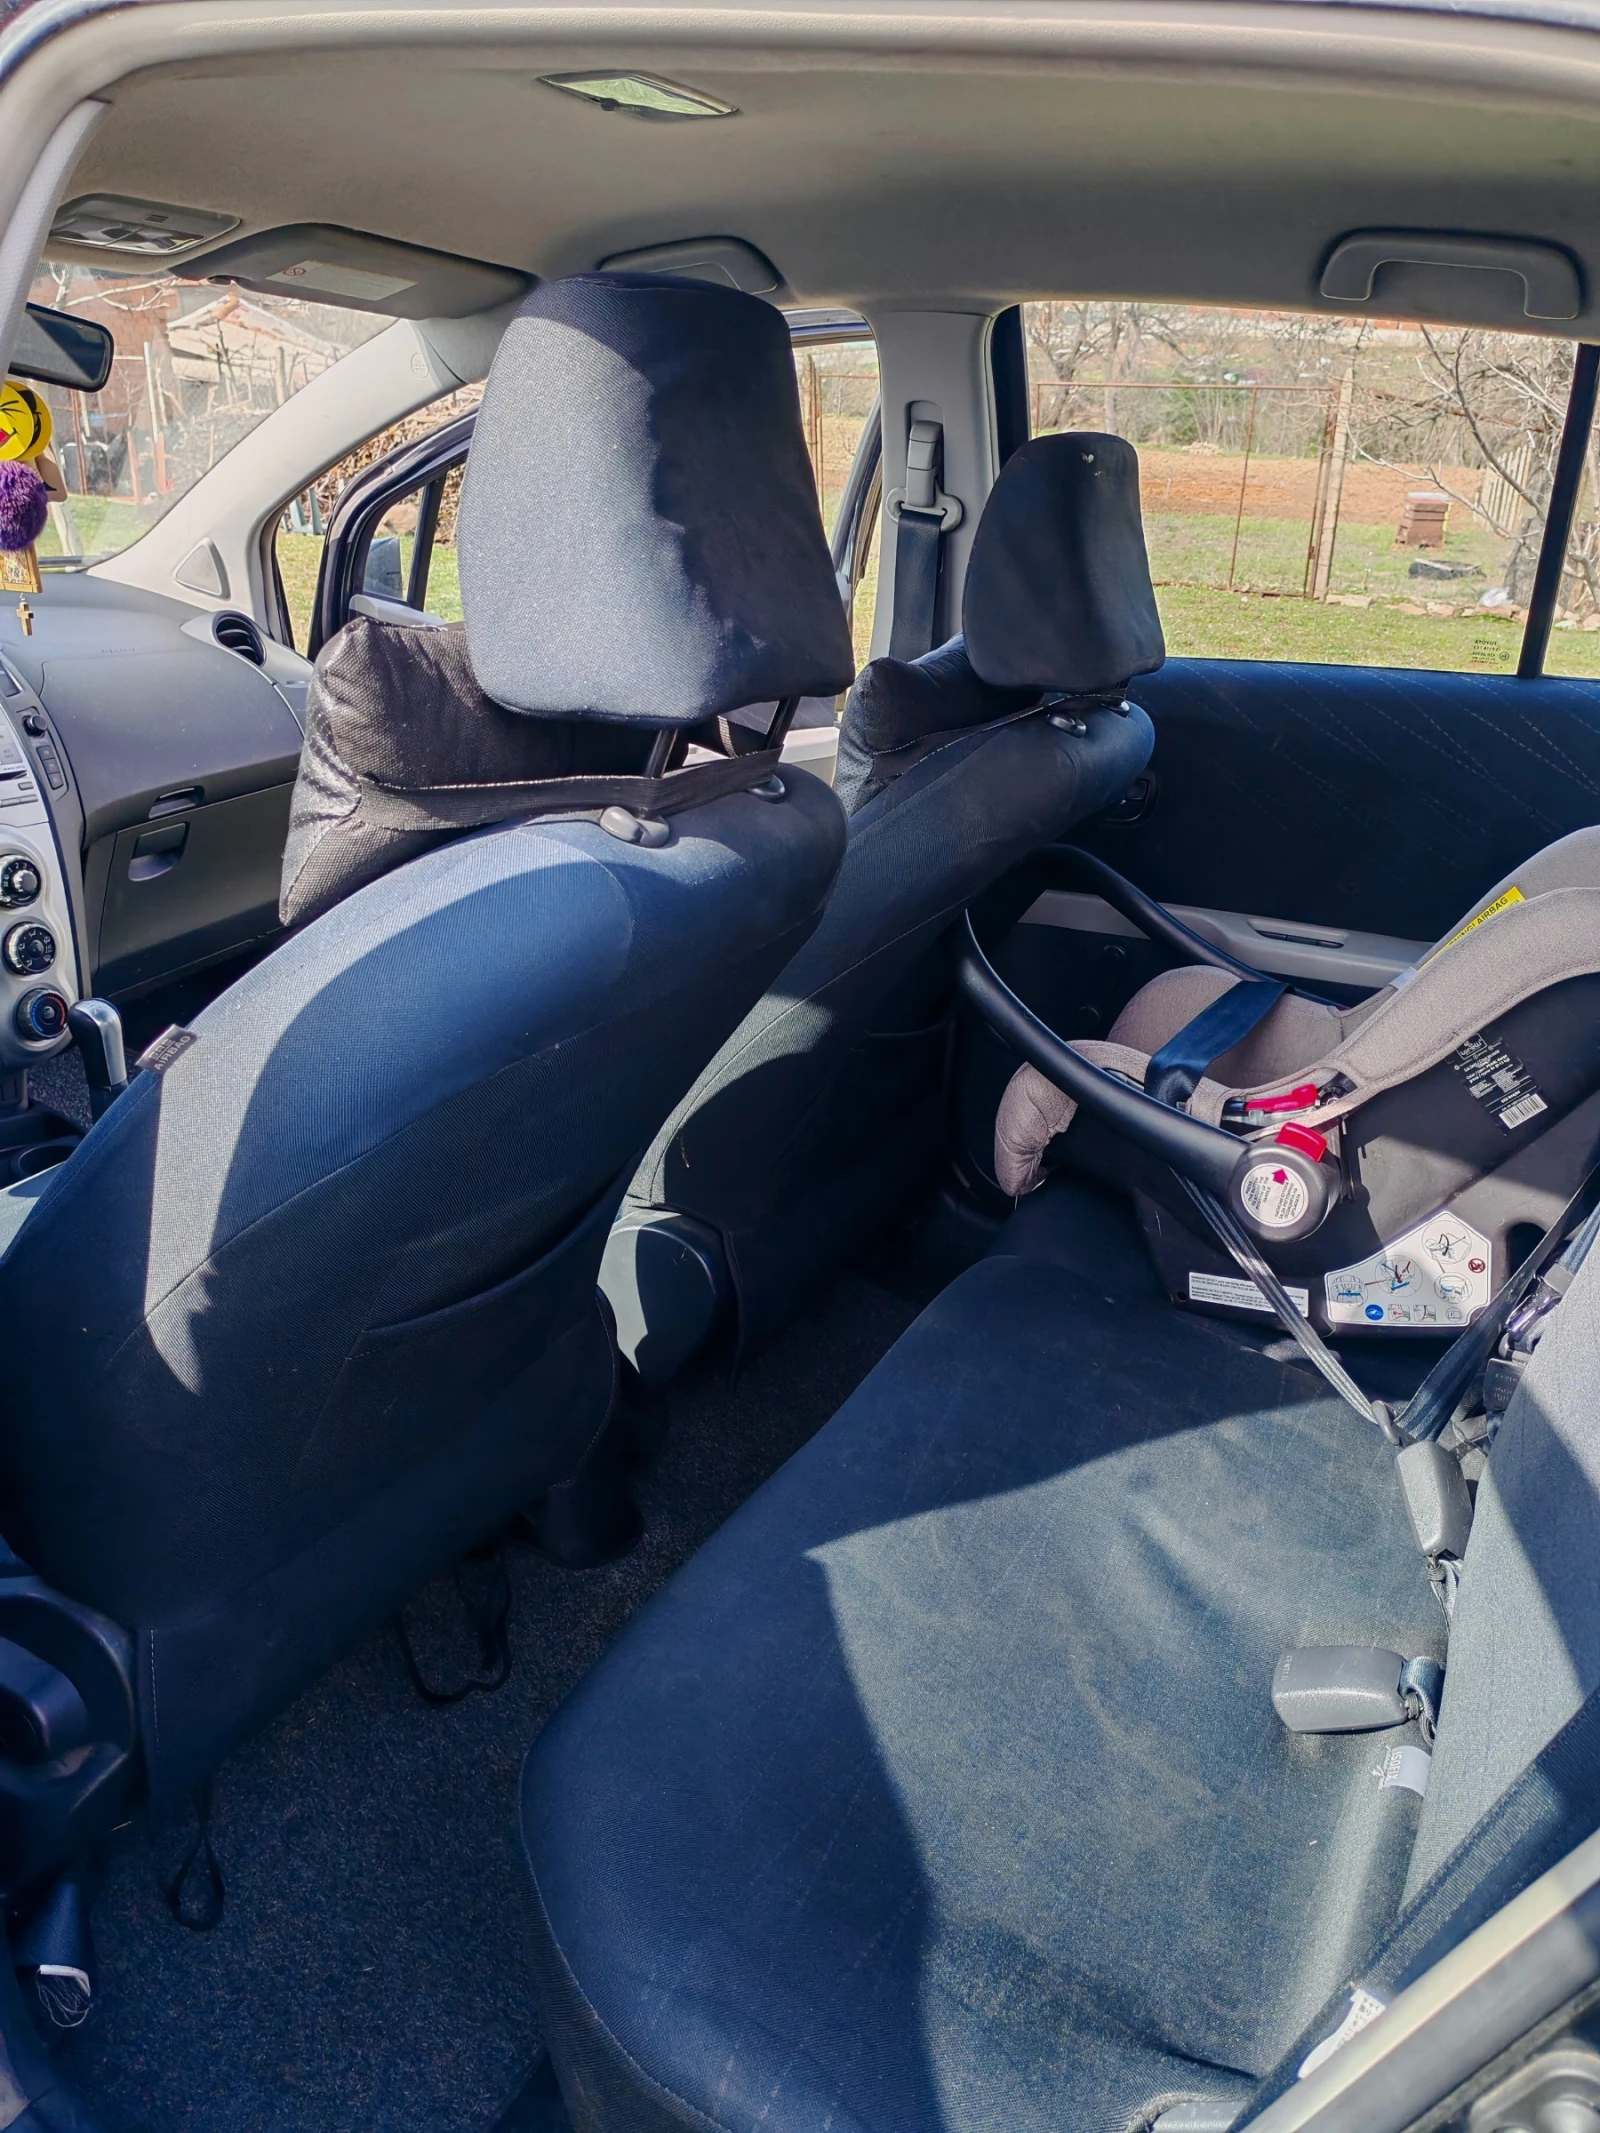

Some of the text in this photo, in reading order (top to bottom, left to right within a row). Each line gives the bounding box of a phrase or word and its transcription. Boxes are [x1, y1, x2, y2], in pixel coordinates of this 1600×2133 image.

[1478, 897, 1508, 924] AIRBAG
[154, 1036, 191, 1070] AIRBAG
[1386, 1752, 1403, 1780] ISOFIX
